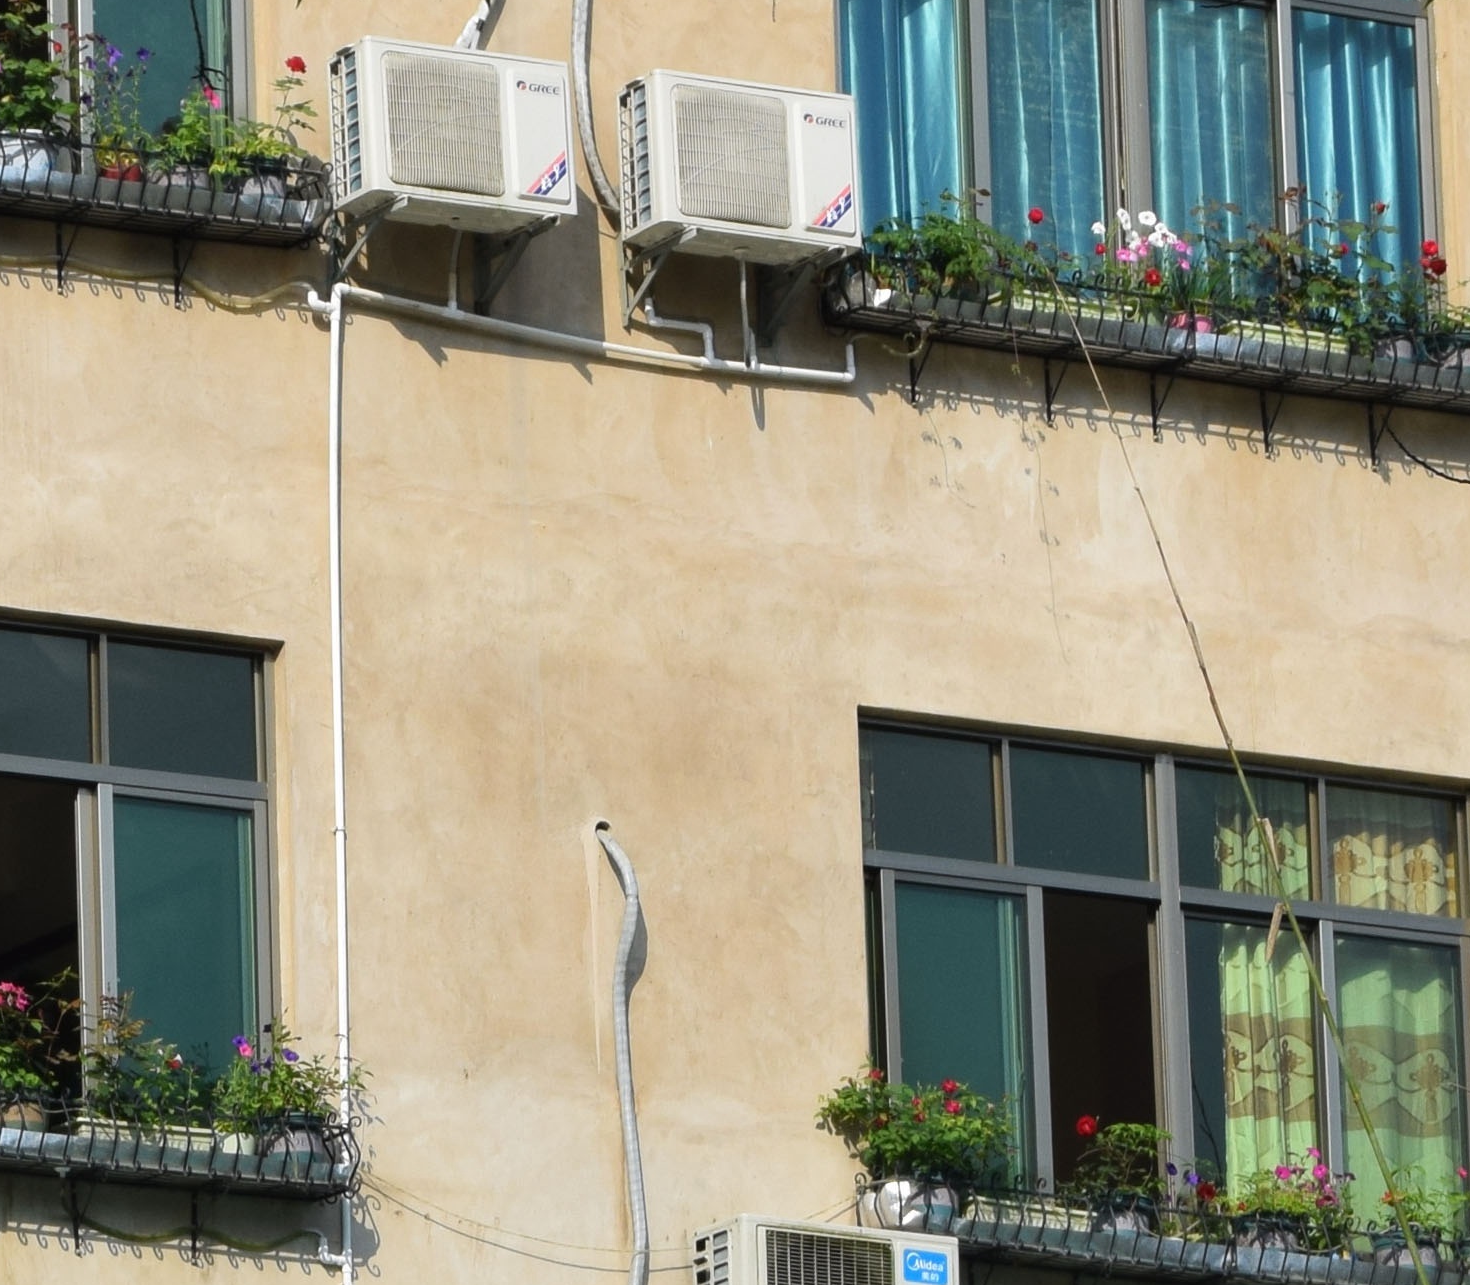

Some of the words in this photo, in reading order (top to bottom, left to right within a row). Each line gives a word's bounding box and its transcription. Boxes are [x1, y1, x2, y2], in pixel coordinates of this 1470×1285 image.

[528, 83, 561, 96] GREE
[815, 115, 847, 129] GREE
[907, 1252, 944, 1272] Midea
